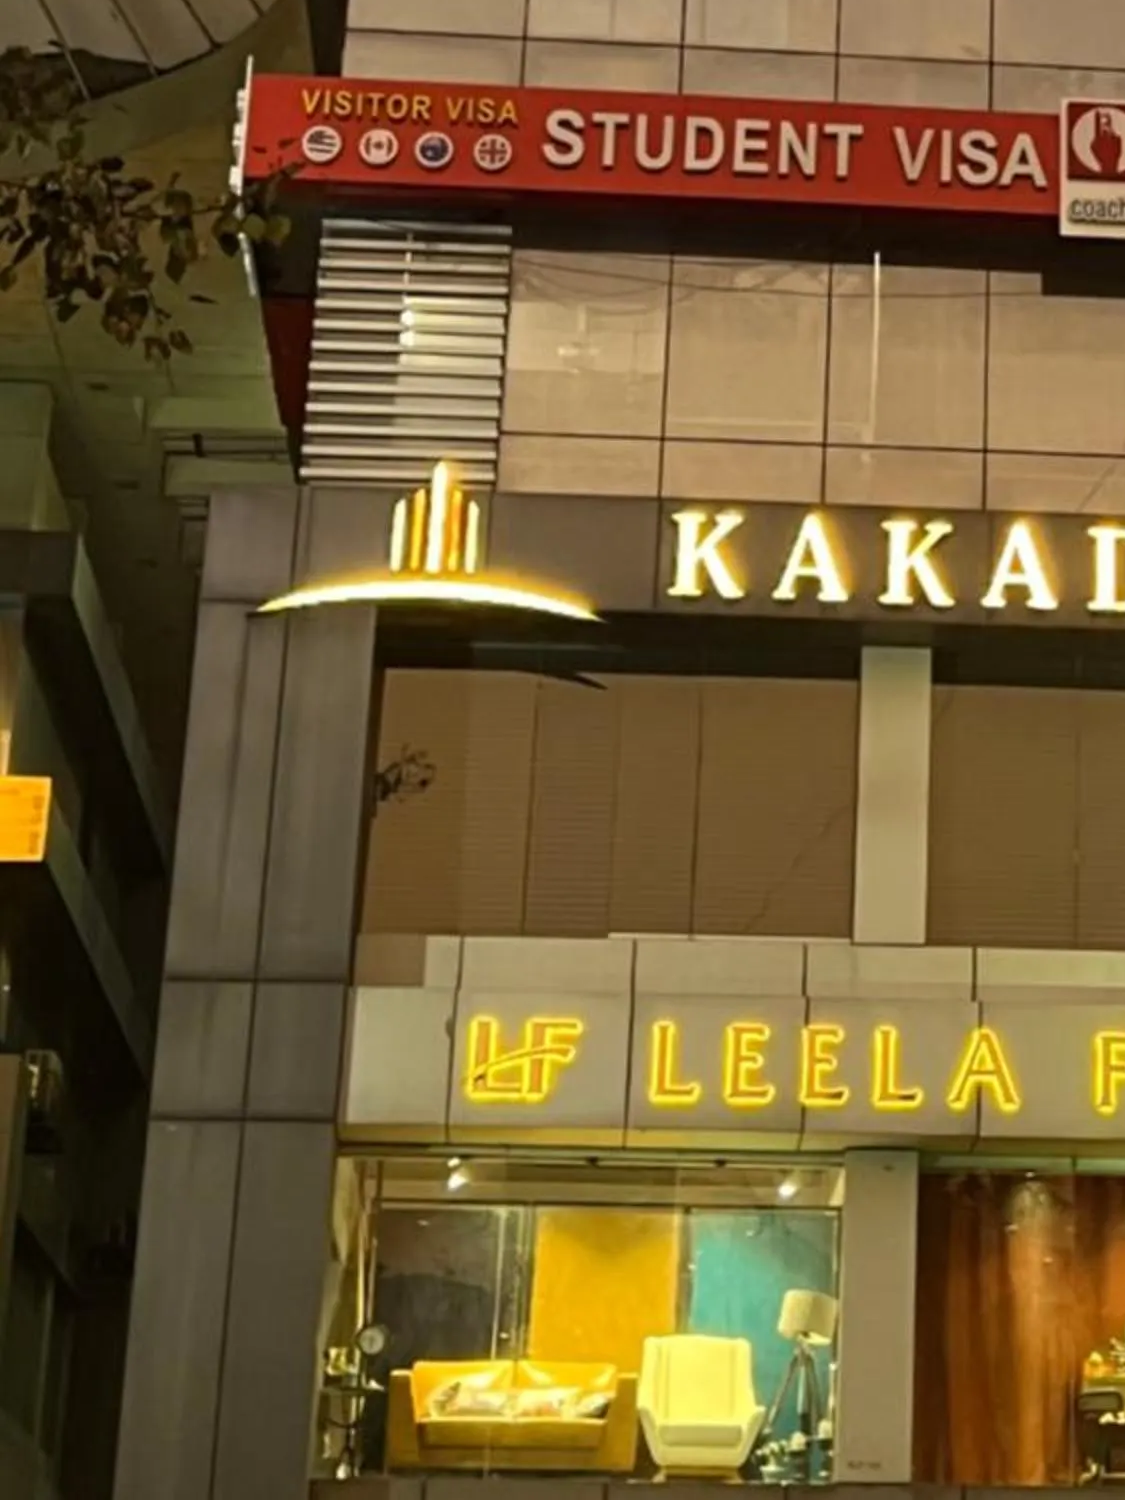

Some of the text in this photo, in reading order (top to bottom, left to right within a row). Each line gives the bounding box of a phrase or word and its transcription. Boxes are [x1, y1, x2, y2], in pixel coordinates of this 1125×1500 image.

[301, 89, 518, 124] VISITOR VISA
[542, 109, 1048, 188] STUDENT VISA
[463, 1015, 583, 1101] LF
[648, 1019, 1021, 1113] LEELA
